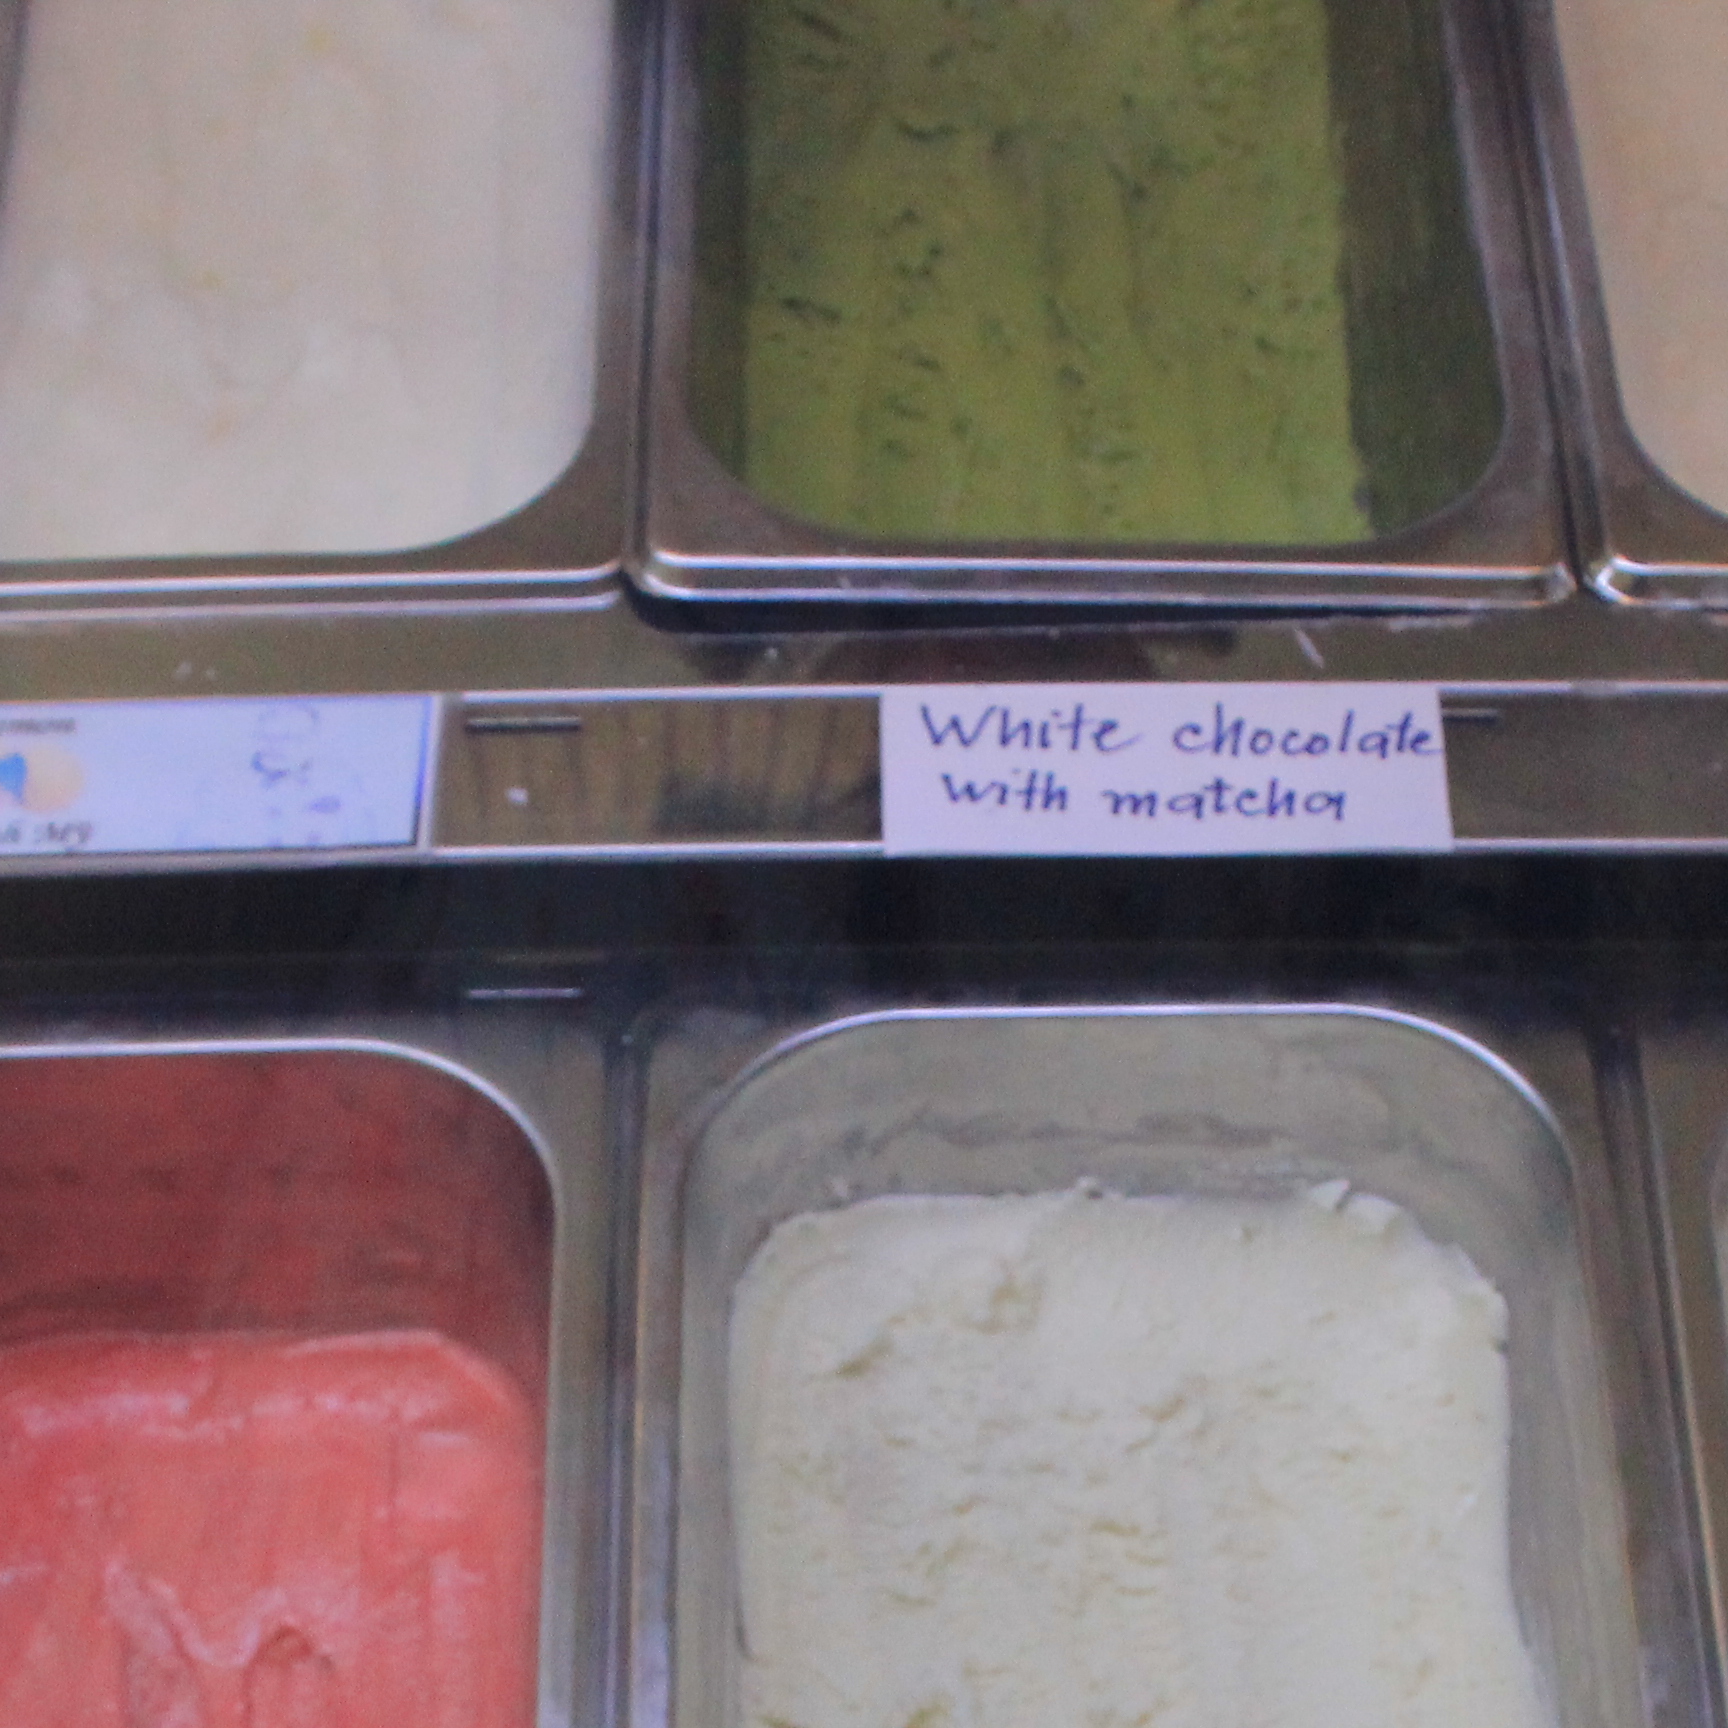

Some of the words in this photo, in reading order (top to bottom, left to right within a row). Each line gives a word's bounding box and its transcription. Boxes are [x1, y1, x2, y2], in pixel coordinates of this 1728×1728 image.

[920, 702, 1142, 754] White
[1172, 702, 1442, 760] chocolate
[940, 768, 1068, 812] with
[1100, 778, 1348, 822] matcha
